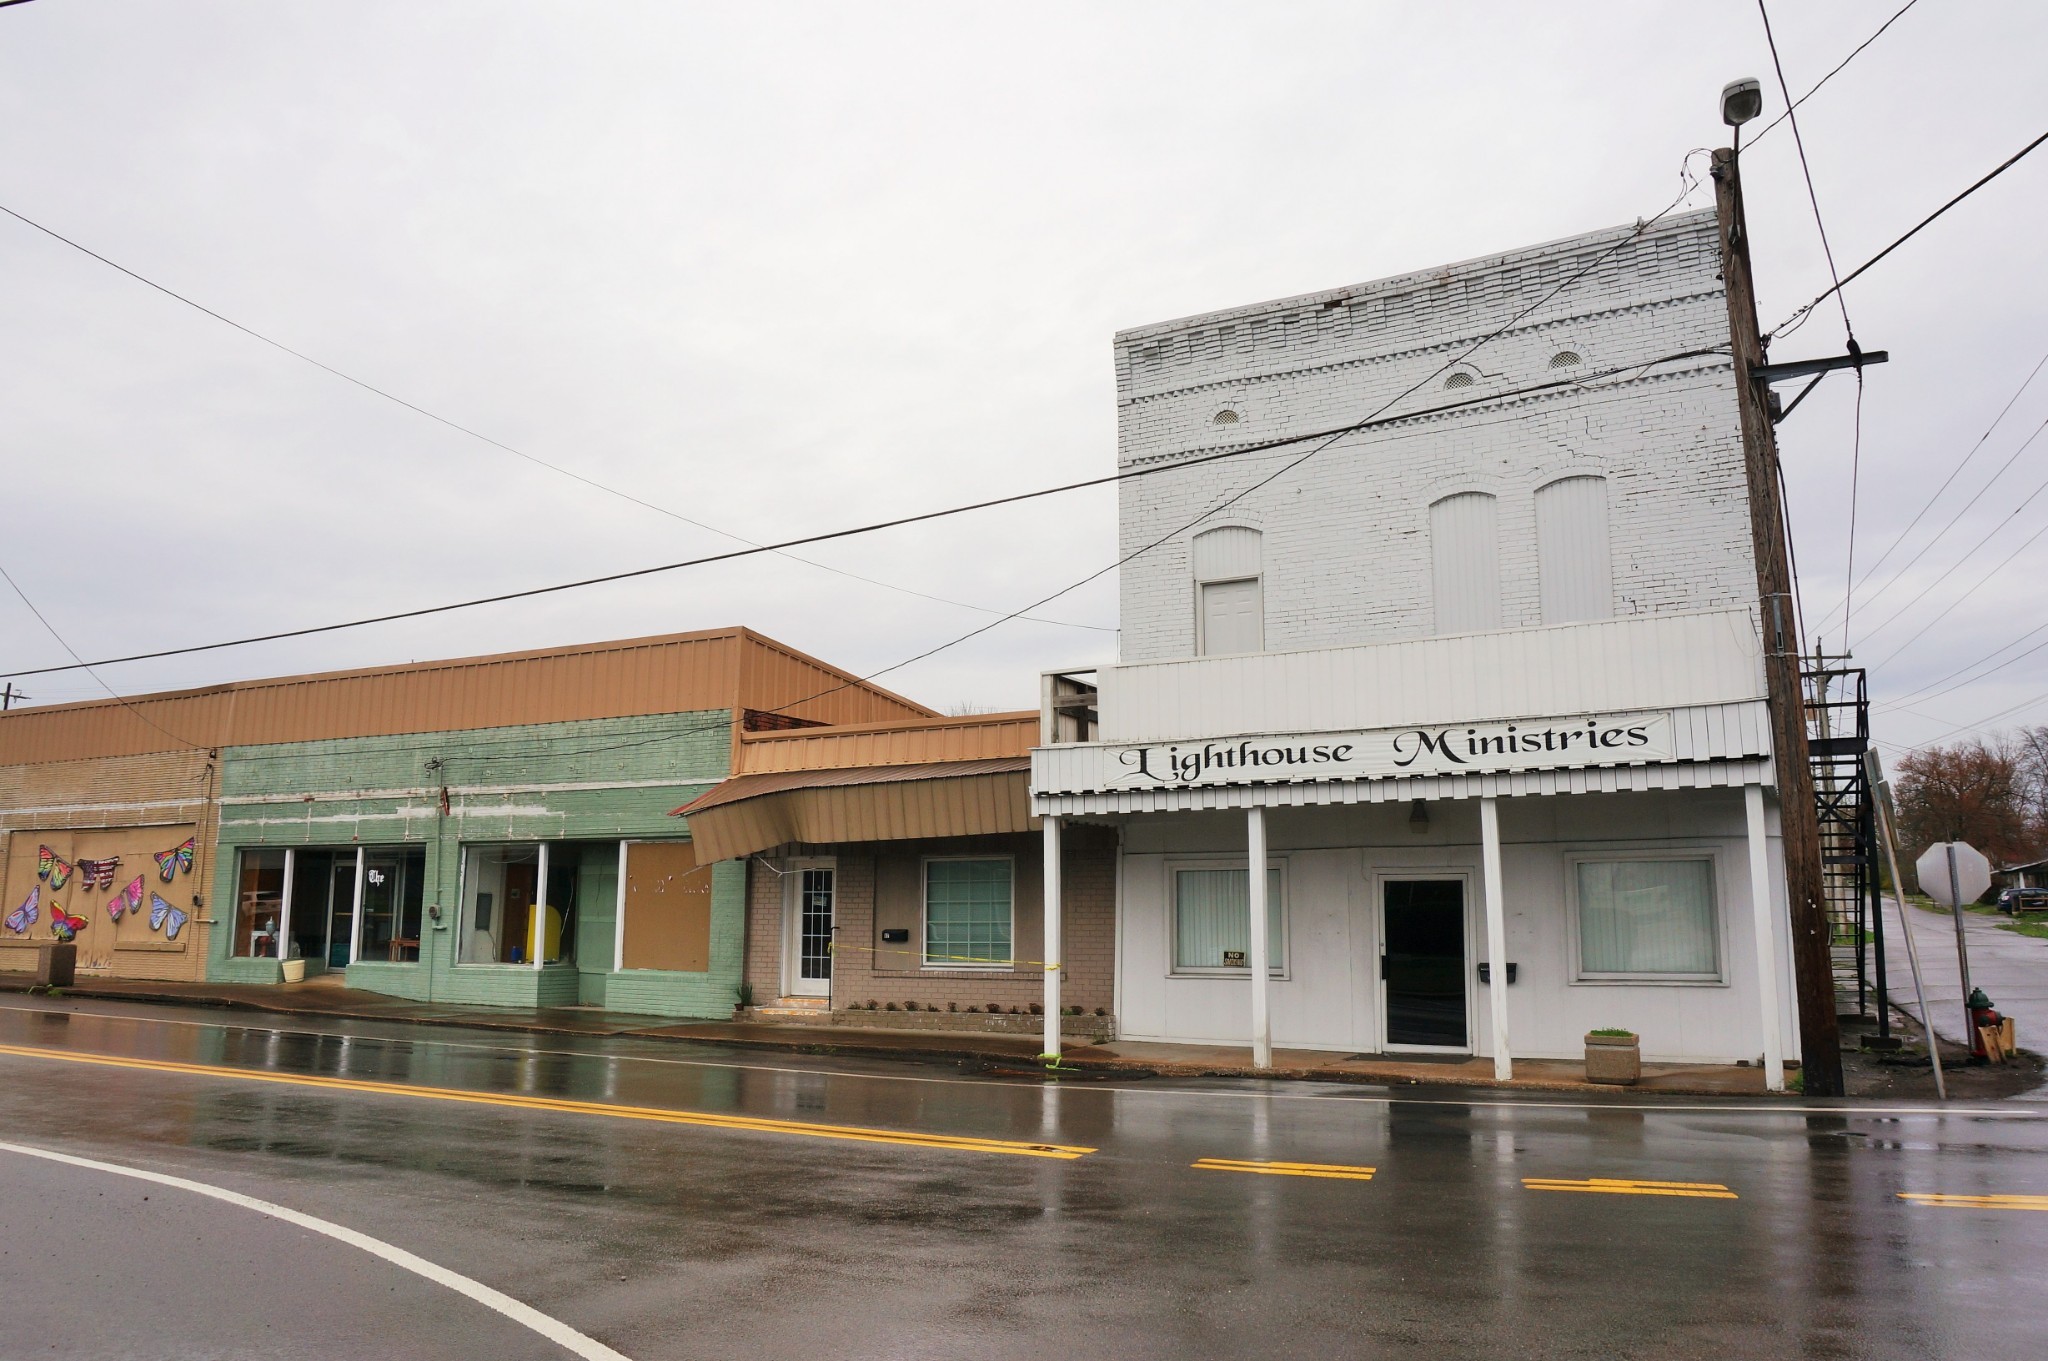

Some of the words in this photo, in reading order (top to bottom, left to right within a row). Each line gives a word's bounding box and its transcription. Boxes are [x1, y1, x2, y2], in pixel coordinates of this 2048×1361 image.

[1119, 741, 1354, 781] Lighthouse
[1393, 721, 1649, 766] Ministries
[368, 869, 385, 887] The
